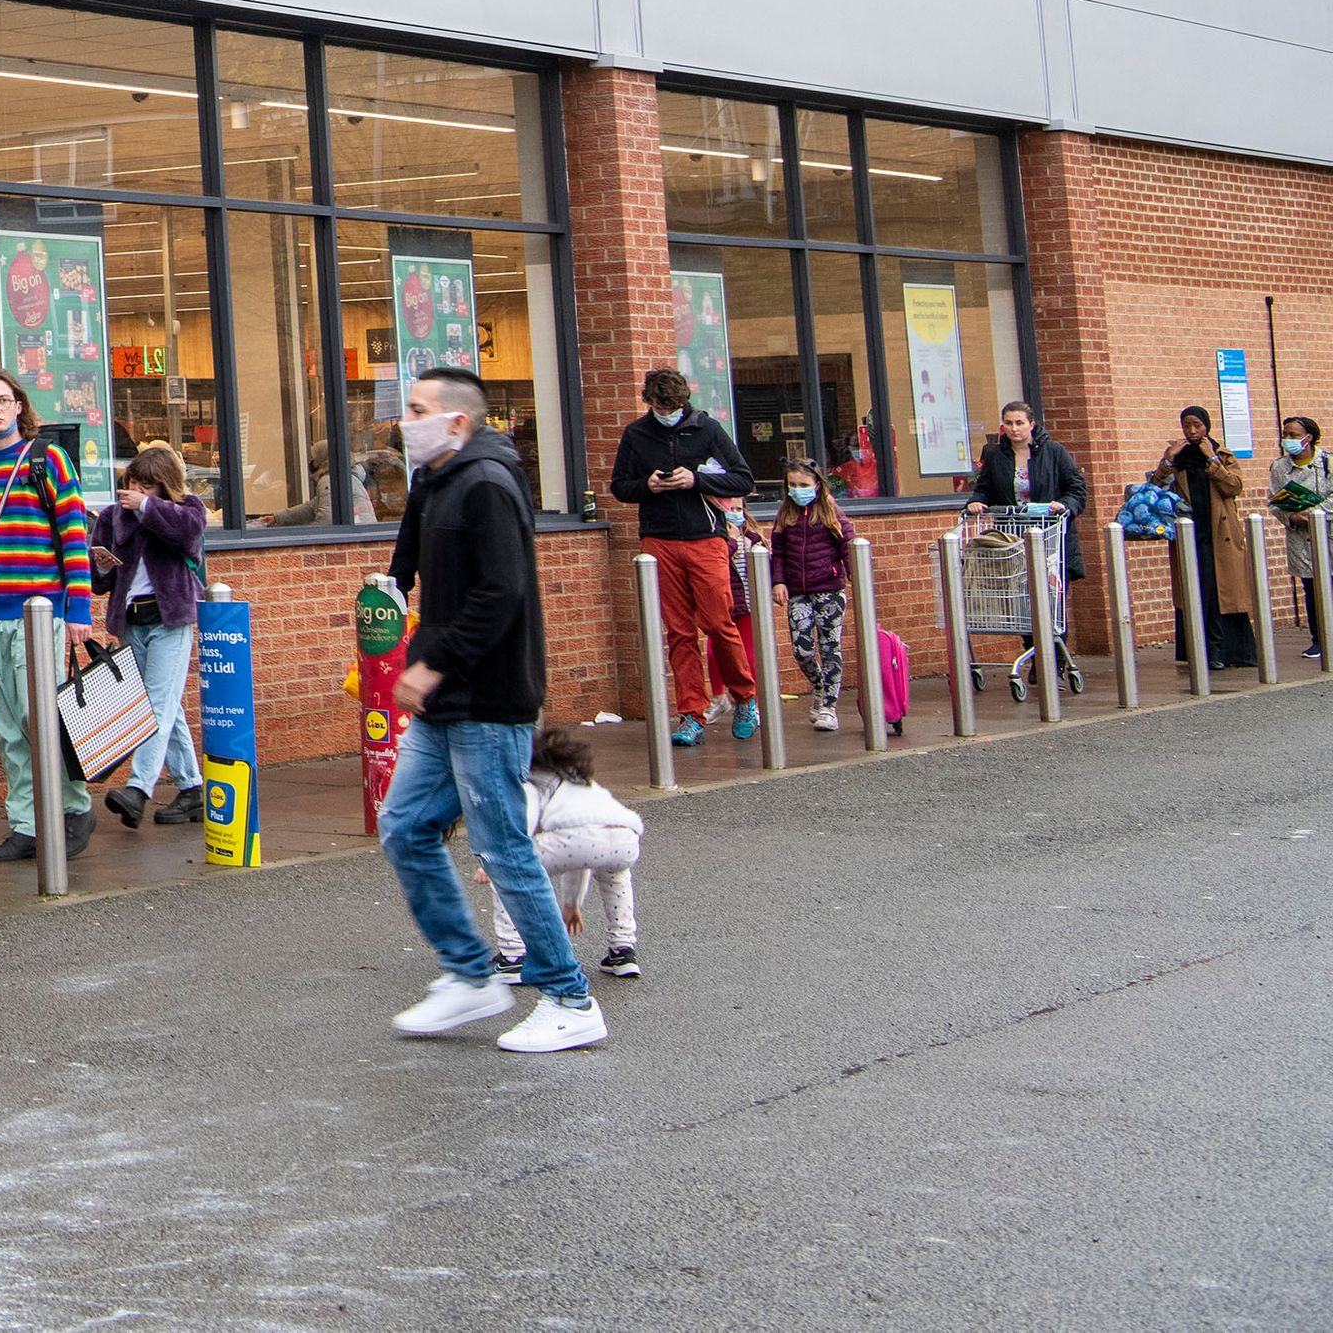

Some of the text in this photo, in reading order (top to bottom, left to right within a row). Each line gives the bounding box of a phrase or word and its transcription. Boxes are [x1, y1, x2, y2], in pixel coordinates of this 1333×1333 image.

[12, 273, 43, 294] Big on
[357, 601, 398, 624] Big on
[203, 630, 247, 644] savings,
[214, 662, 235, 674] Lidl
[226, 707, 245, 715] new
[217, 719, 235, 729] app.
